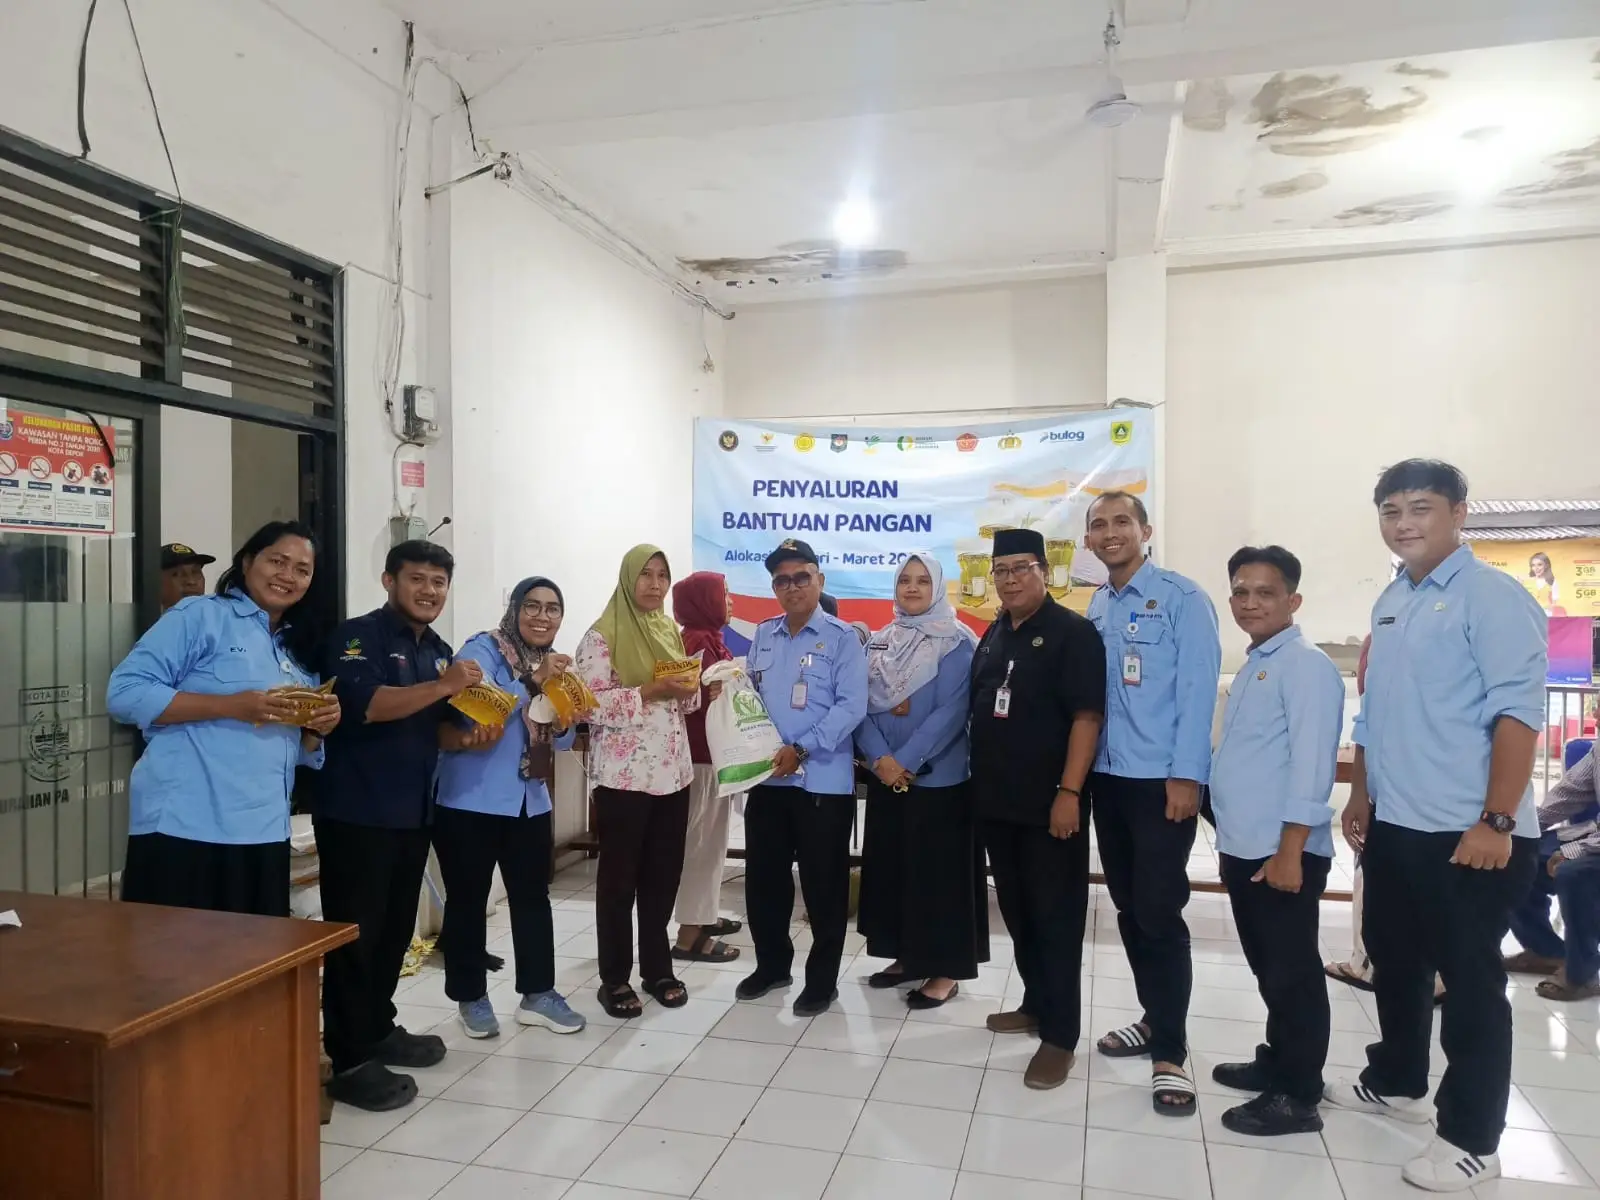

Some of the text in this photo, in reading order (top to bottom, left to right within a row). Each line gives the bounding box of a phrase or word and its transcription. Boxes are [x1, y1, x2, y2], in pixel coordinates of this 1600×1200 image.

[17, 426, 58, 440] KAWASAN
[59, 432, 83, 443] TANPA
[1050, 430, 1084, 441] bulog
[47, 446, 64, 455] KOTA
[65, 442, 85, 451] TAHUN
[752, 479, 899, 499] PENYALURAN
[722, 511, 932, 533] BANTUAN PANGAN
[725, 550, 771, 563] Alokas
[842, 552, 884, 565] Maret
